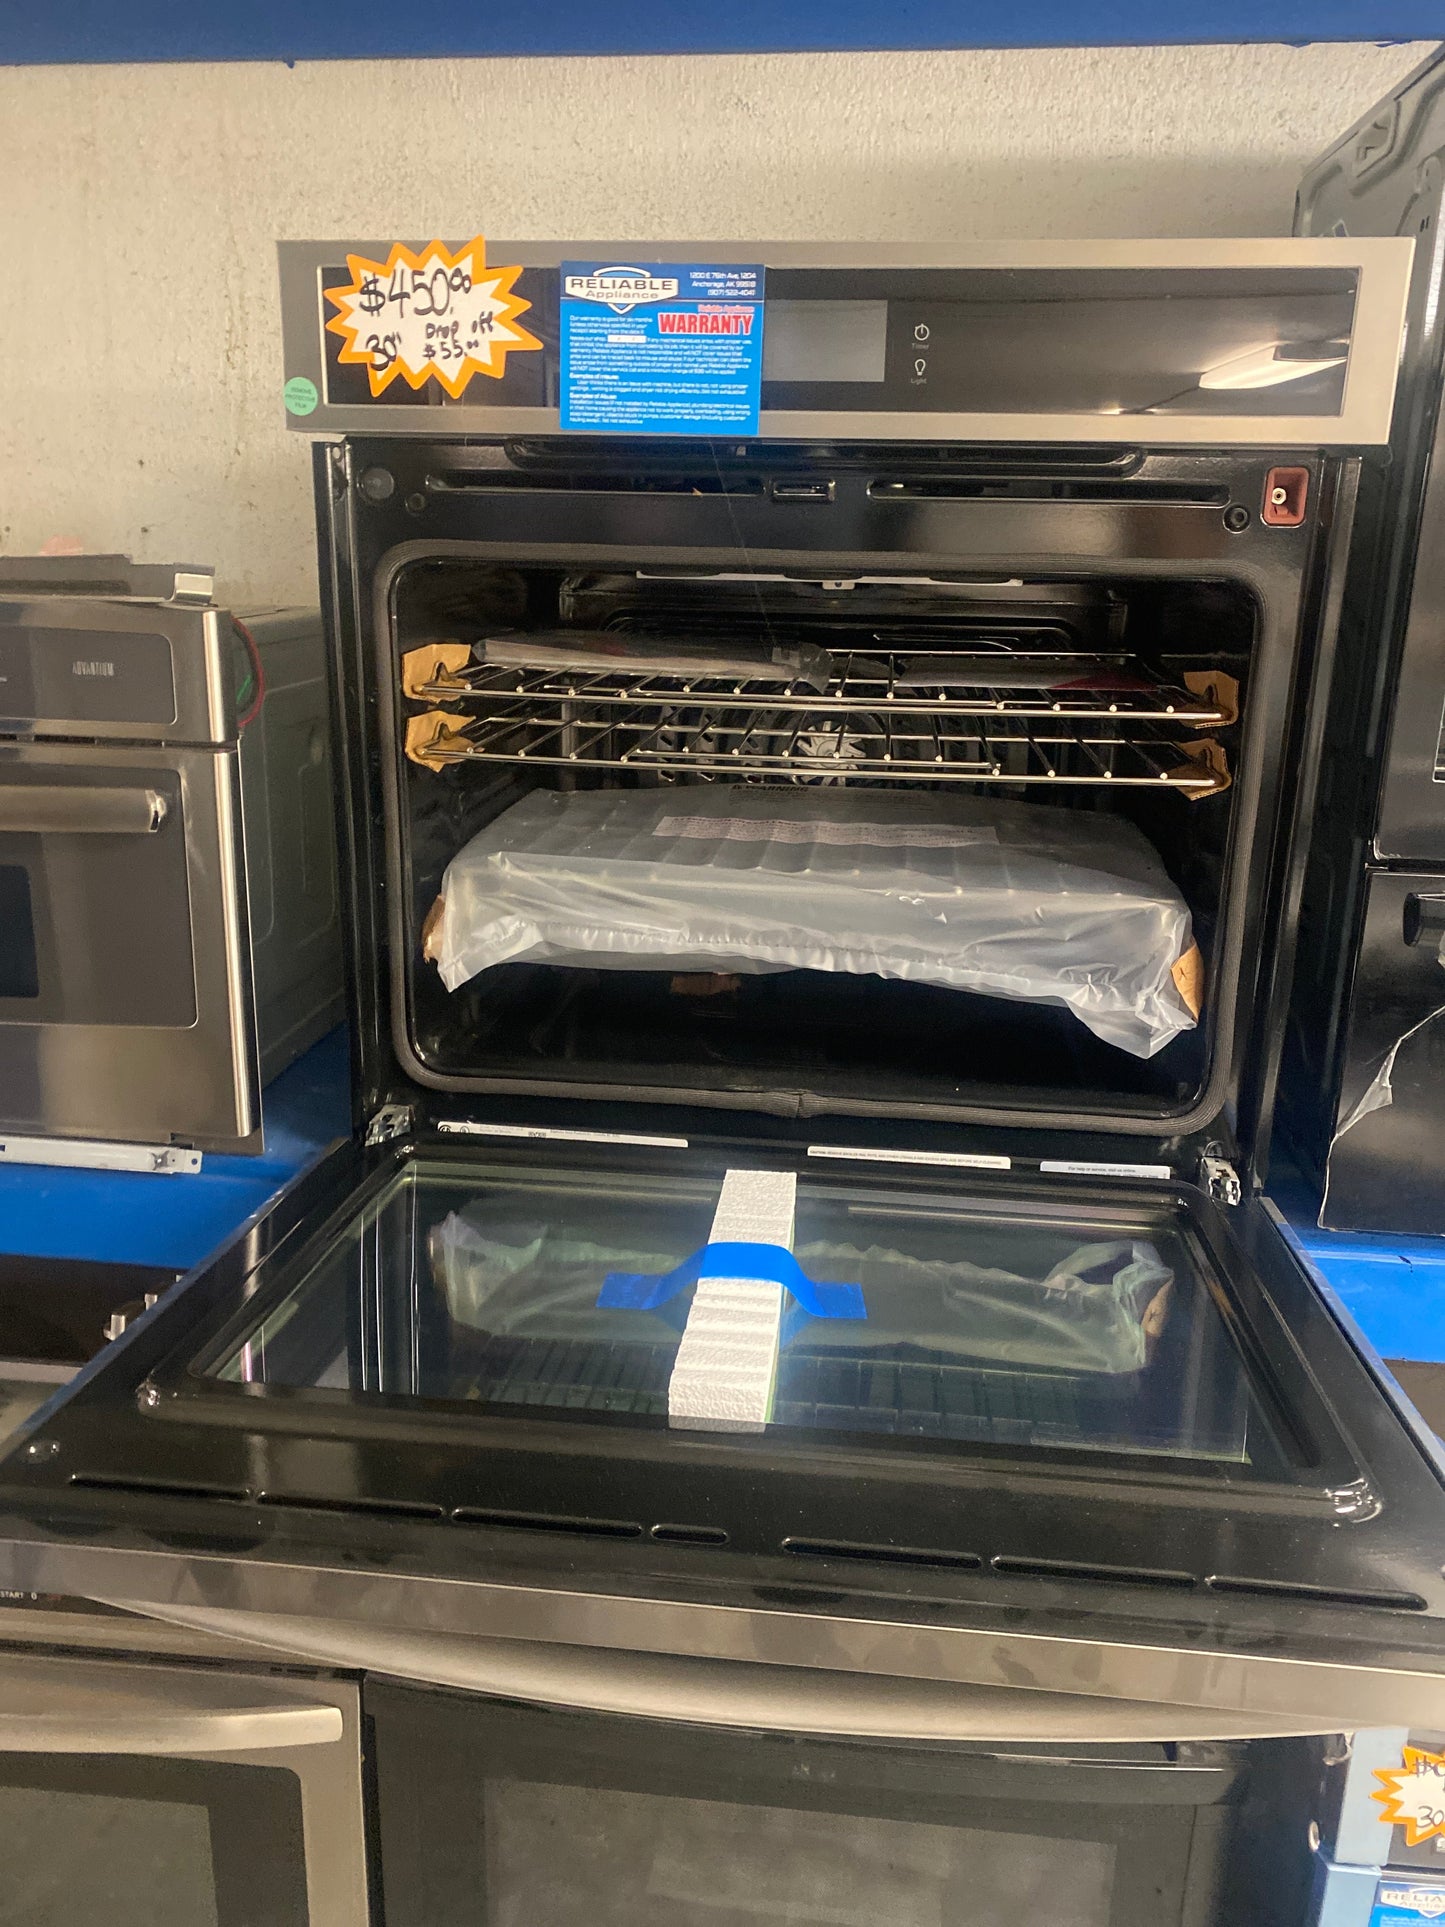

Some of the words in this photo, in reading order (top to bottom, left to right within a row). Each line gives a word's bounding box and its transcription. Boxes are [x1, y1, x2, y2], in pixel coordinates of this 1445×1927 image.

[571, 278, 673, 290] RELIABLE
[585, 290, 659, 300] Appliance
[426, 320, 459, 340] Drop
[472, 310, 495, 335] off
[659, 313, 753, 335] WARRANTY
[0, 1590, 24, 1598] START
